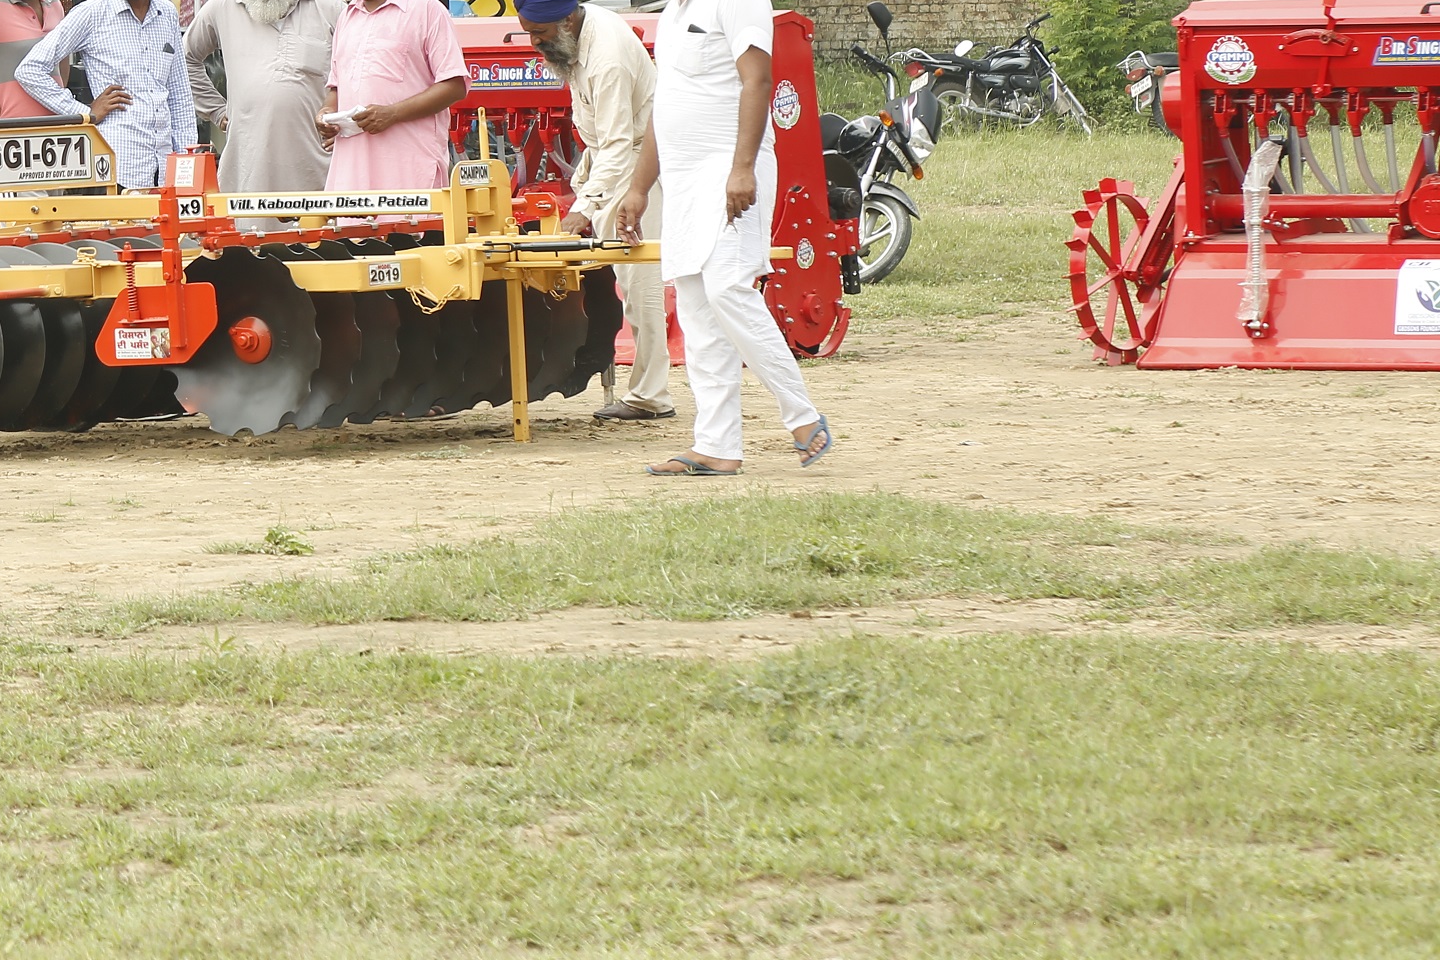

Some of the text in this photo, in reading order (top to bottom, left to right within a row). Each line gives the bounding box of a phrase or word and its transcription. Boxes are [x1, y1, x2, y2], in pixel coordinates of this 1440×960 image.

[1380, 36, 1440, 55] BIR SING
[1211, 52, 1250, 61] PAMMI
[471, 64, 489, 81] BIR
[491, 63, 523, 81] SINGH
[525, 68, 532, 80] &
[775, 94, 797, 107] PAMMI
[19, 171, 44, 180] APPROVED
[53, 170, 66, 178] GOVT.
[67, 169, 73, 177] OF
[74, 169, 88, 177] INDIA
[229, 199, 254, 210] Vill.
[336, 197, 374, 208] Distt.
[377, 196, 428, 207] Patiala
[370, 267, 399, 282] 2019
